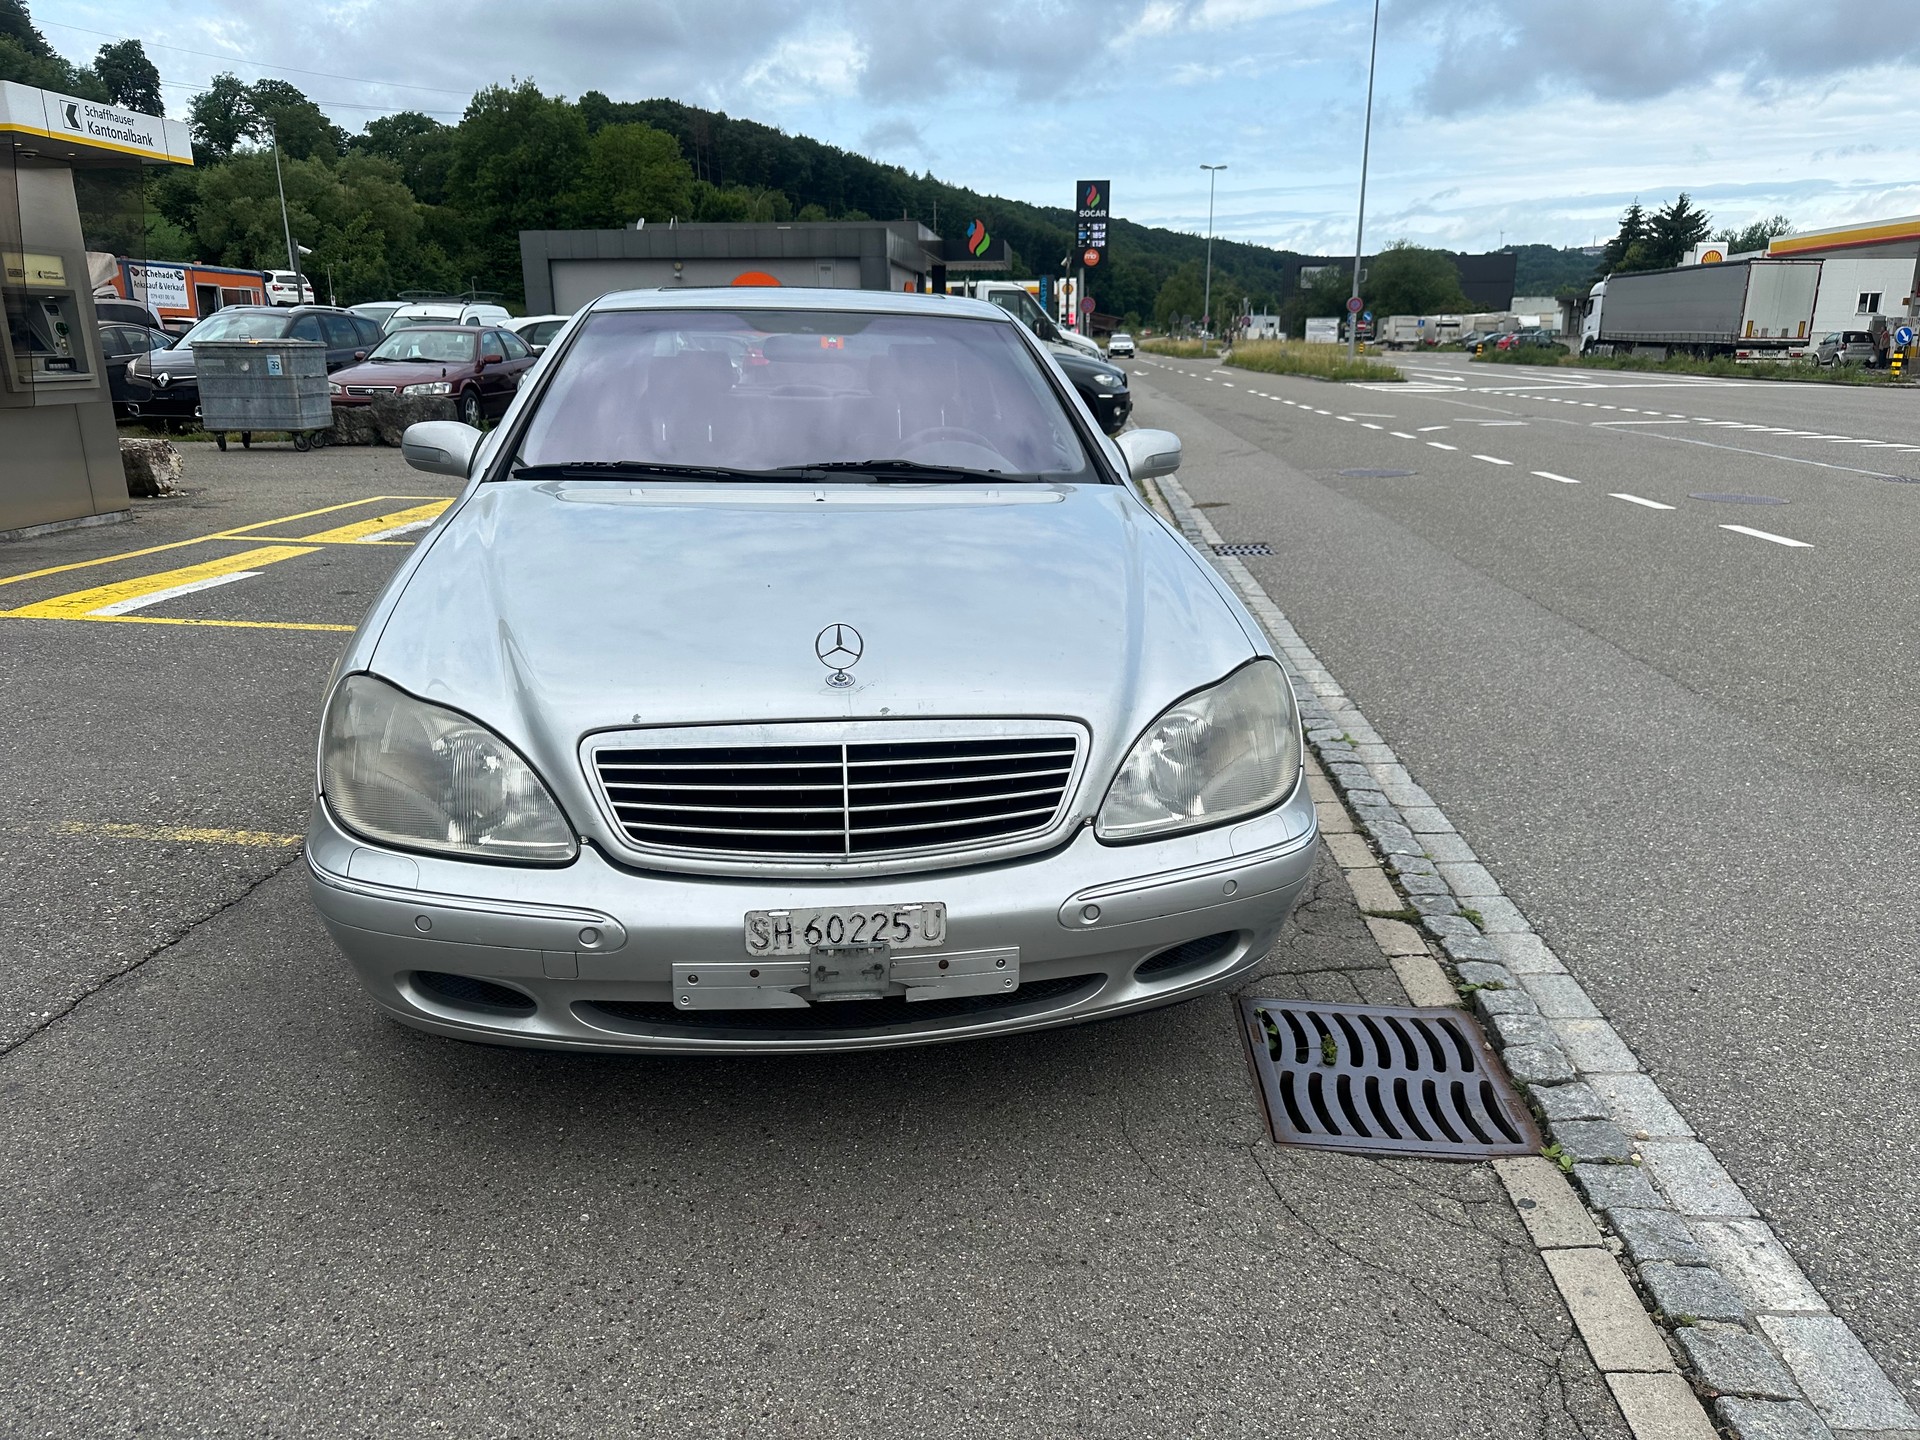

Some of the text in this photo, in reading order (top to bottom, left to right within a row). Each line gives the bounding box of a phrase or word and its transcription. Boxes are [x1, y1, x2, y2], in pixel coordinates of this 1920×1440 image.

[84, 105, 135, 126] Schaffhauser
[87, 120, 154, 147] Kantonalbank
[1079, 209, 1107, 218] SOCAR
[164, 282, 185, 291] Verkauf
[270, 360, 280, 370] 33
[749, 908, 943, 950] SH 60225 U
